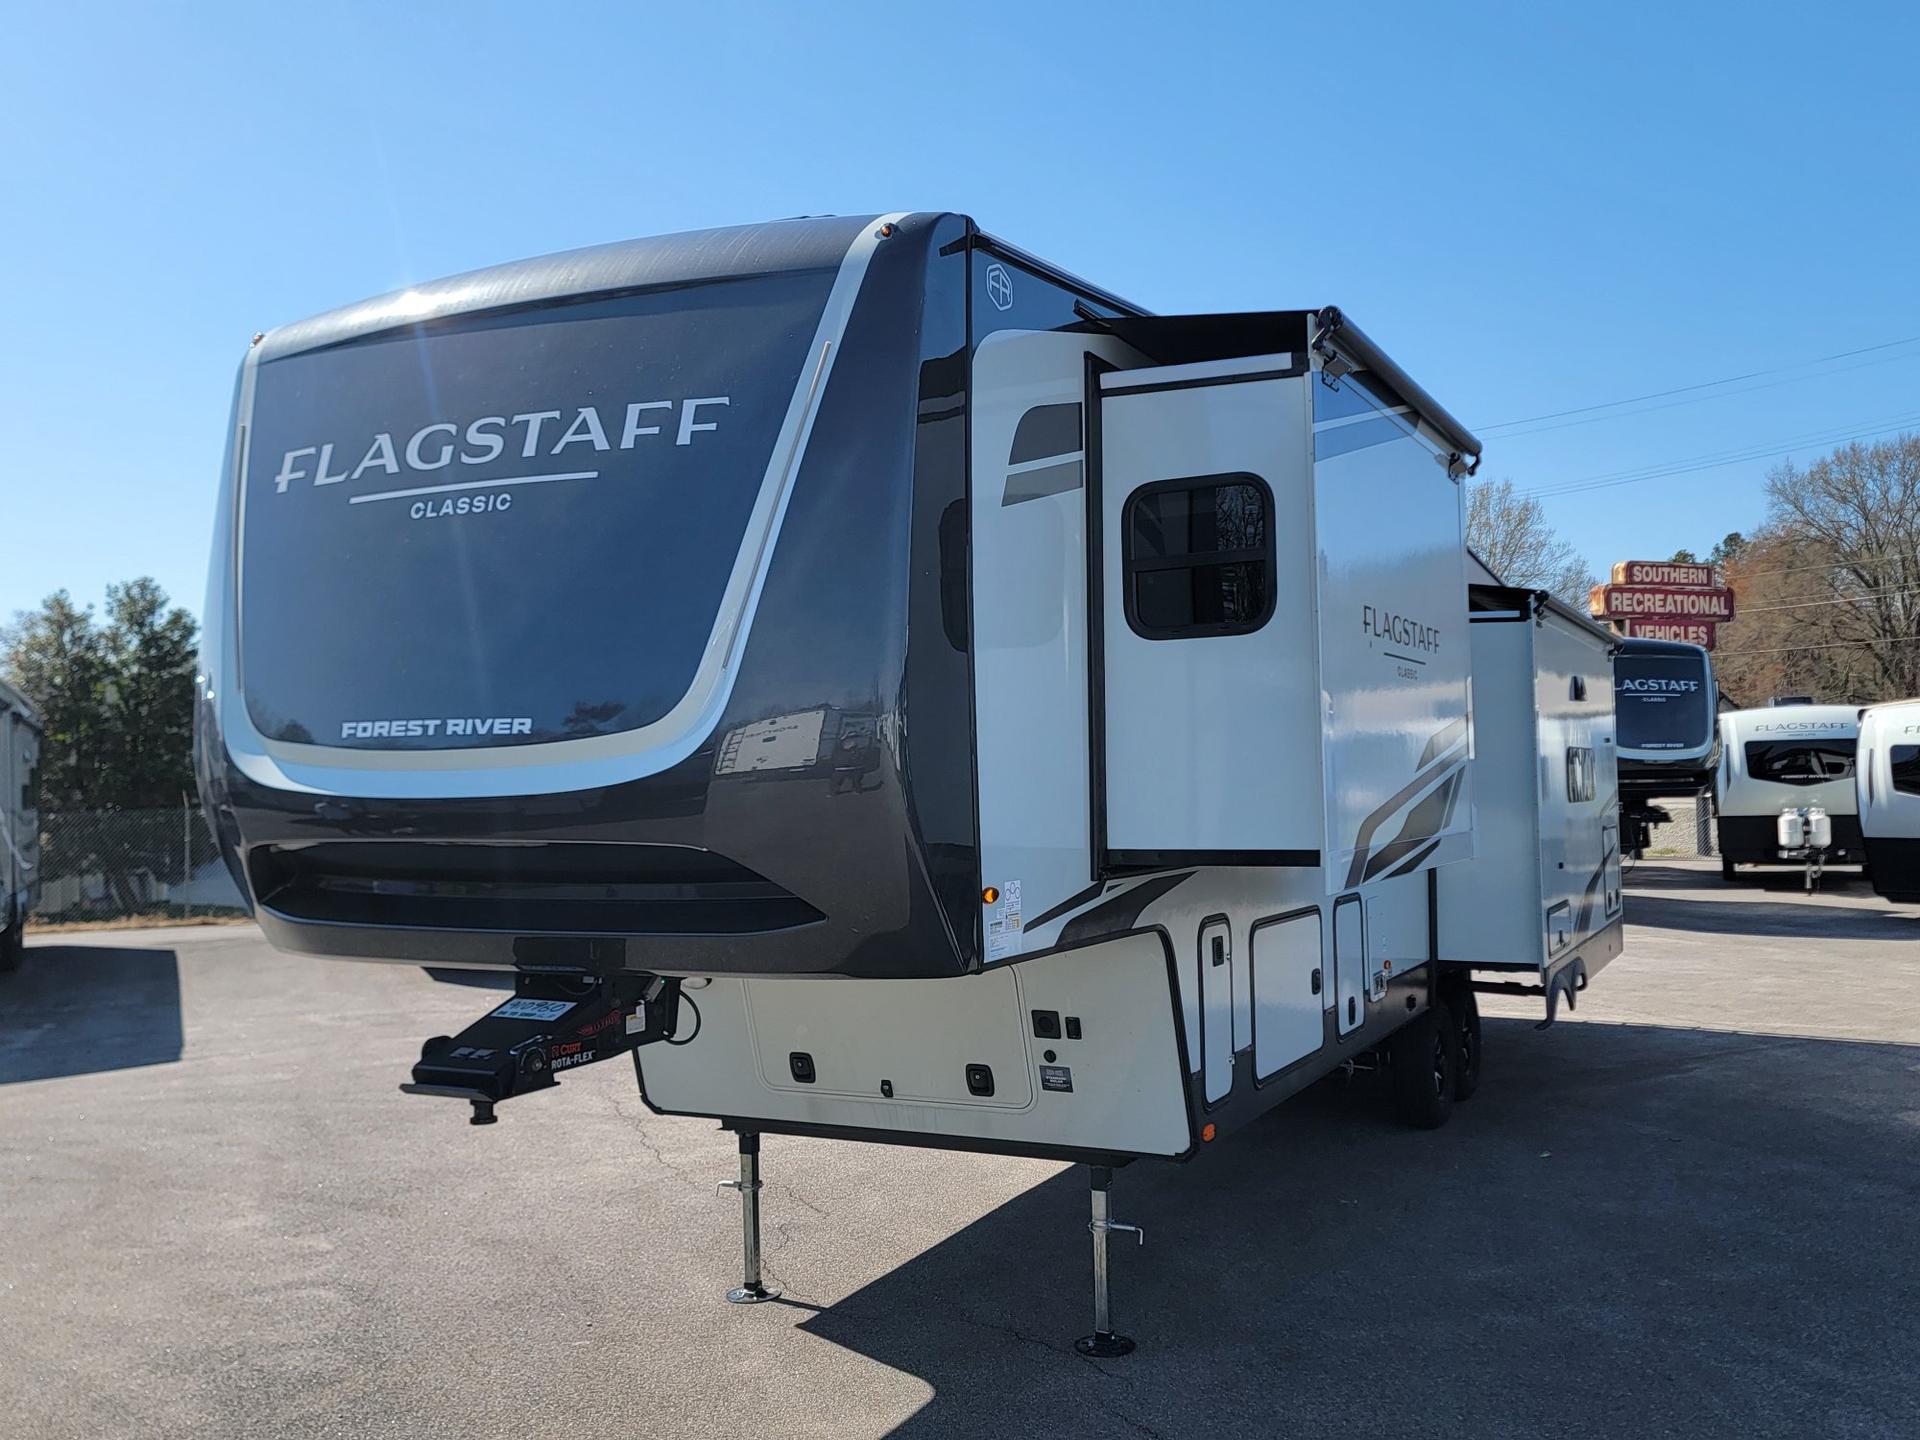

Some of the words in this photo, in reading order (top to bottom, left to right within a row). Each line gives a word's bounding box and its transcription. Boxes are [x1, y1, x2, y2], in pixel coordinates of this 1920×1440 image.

[275, 396, 730, 494] FLAGSTAFF
[410, 493, 513, 520] CLASSIC
[1633, 566, 1708, 584] SOUTHERN
[1611, 592, 1729, 615] RECREATIONAL
[1363, 605, 1440, 654] FLAGSTAFF
[1635, 625, 1708, 645] VEHICLES
[341, 719, 442, 739] FOREST
[446, 717, 533, 735] RIVER
[1755, 722, 1849, 732] FLAGSTAFF
